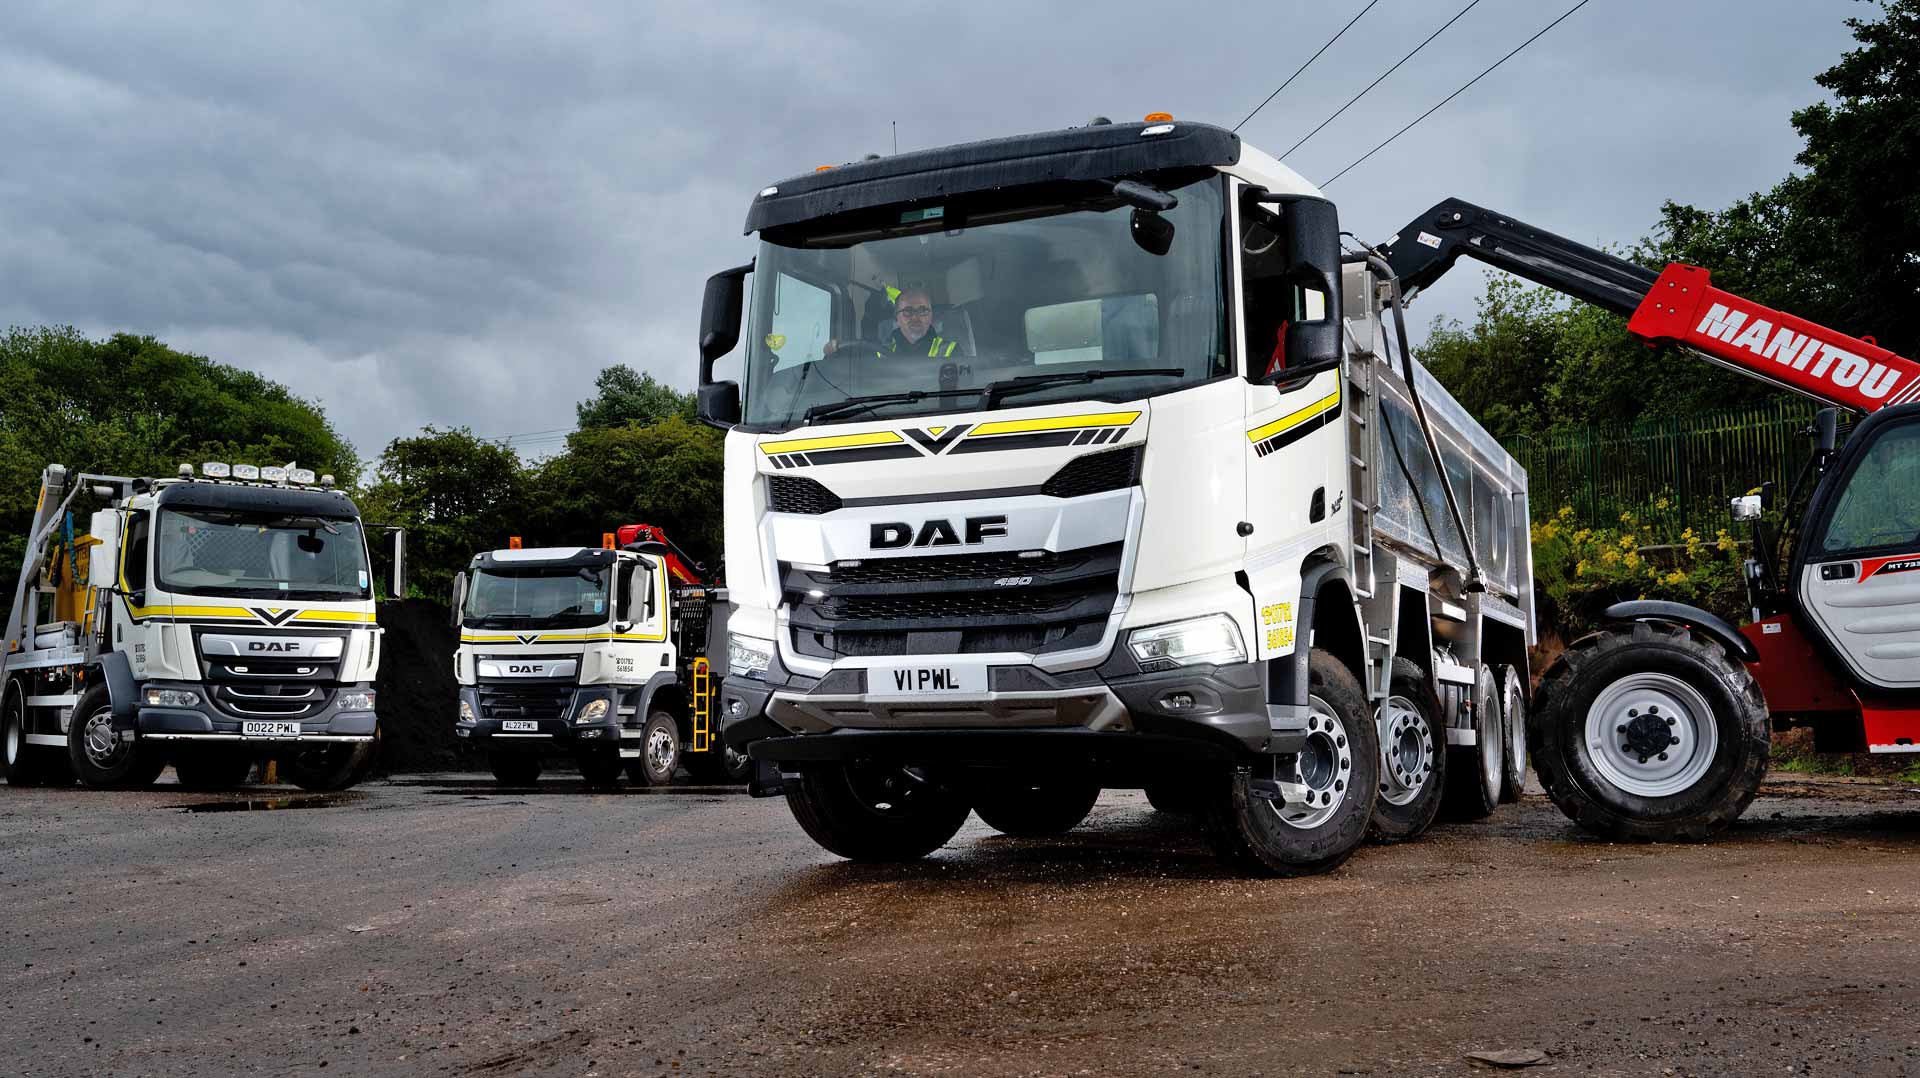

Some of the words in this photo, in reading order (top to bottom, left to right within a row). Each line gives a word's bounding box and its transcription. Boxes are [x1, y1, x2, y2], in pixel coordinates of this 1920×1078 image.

[1696, 302, 1902, 399] MANITOU
[869, 514, 1008, 550] DAF
[994, 576, 1033, 586] 450
[248, 641, 300, 651] DAF
[509, 665, 543, 673] DAF
[918, 668, 959, 690] PWL
[276, 723, 297, 733] PWL
[505, 721, 522, 729] AL22
[522, 722, 536, 730] PWL
